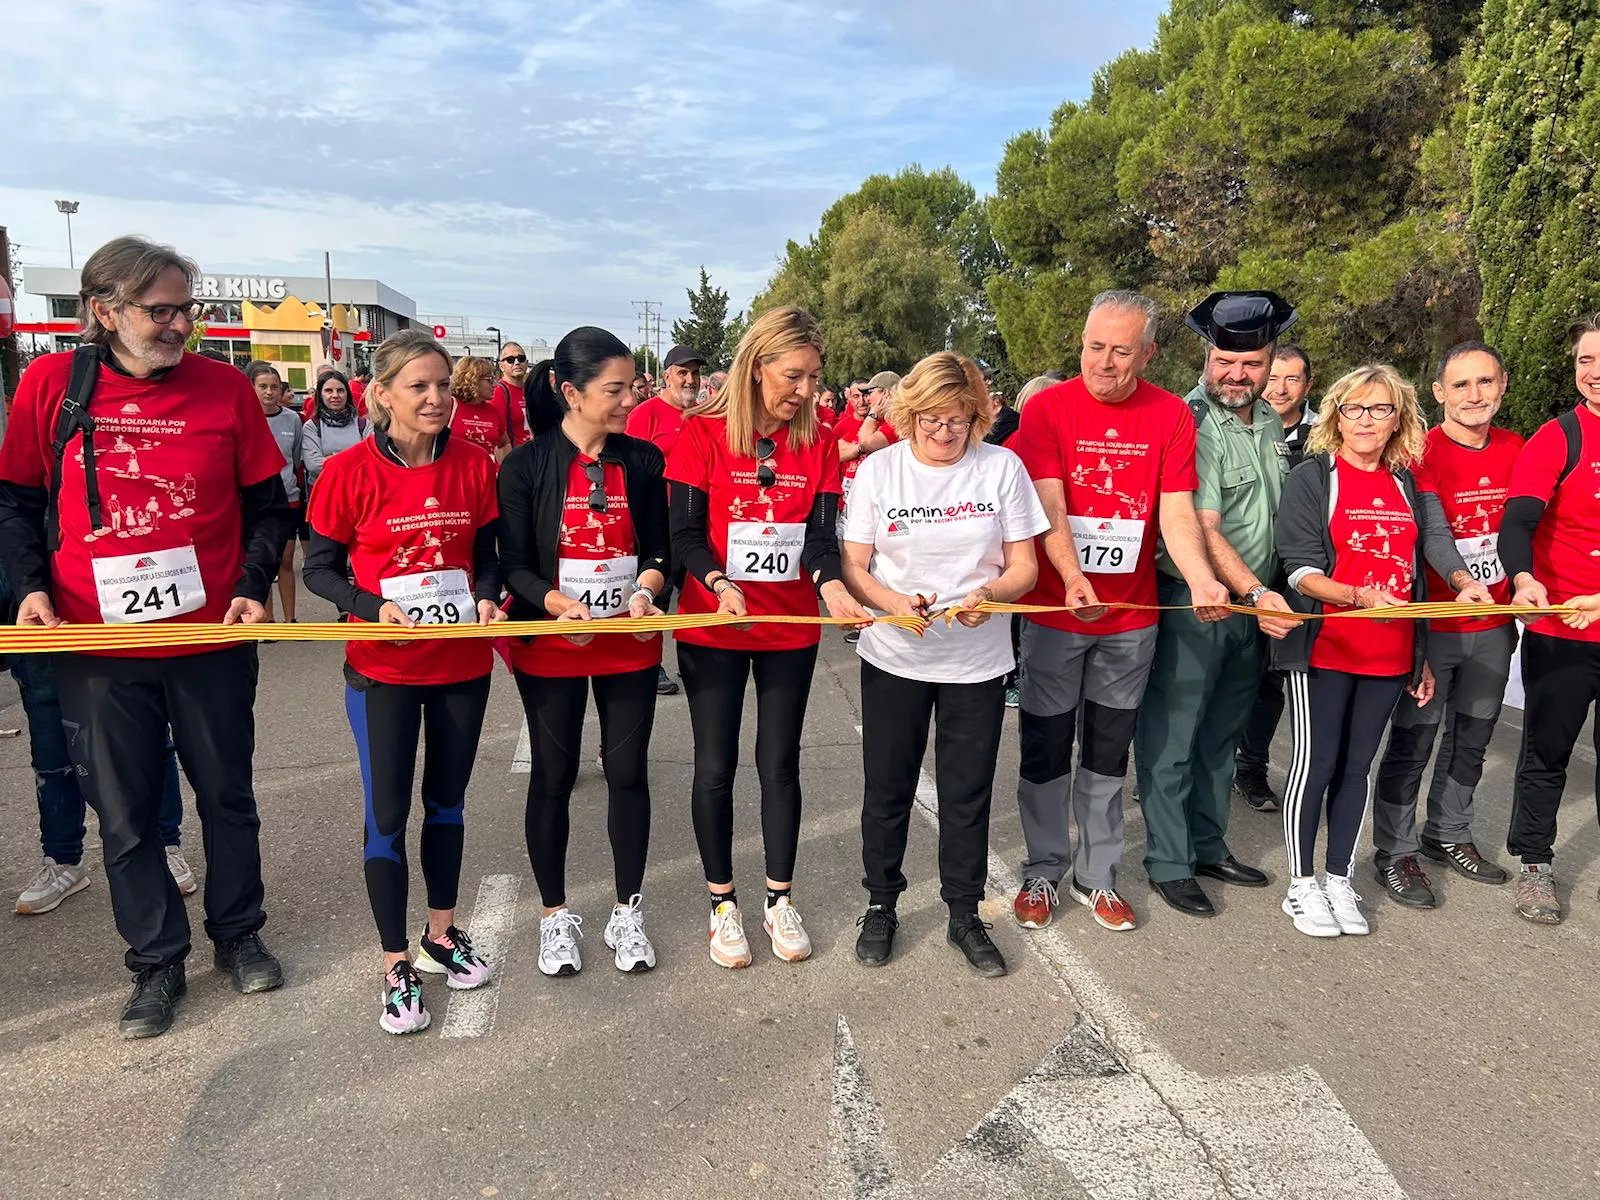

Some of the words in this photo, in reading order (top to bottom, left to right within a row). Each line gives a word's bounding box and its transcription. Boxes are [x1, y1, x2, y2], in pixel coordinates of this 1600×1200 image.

[192, 277, 219, 297] ER
[224, 278, 286, 299] KING
[93, 417, 119, 425] RCHA
[120, 417, 167, 426] SOLIDARIA
[95, 425, 140, 433] SCLEROSIS
[141, 426, 182, 434] MÚLTIPLE
[392, 514, 426, 525] MARCHA
[744, 551, 789, 574] 240
[1080, 545, 1123, 567] 179
[140, 573, 149, 581] POR
[1470, 558, 1498, 581] 361
[121, 582, 181, 615] 241
[578, 588, 622, 611] 445
[407, 602, 460, 625] 239
